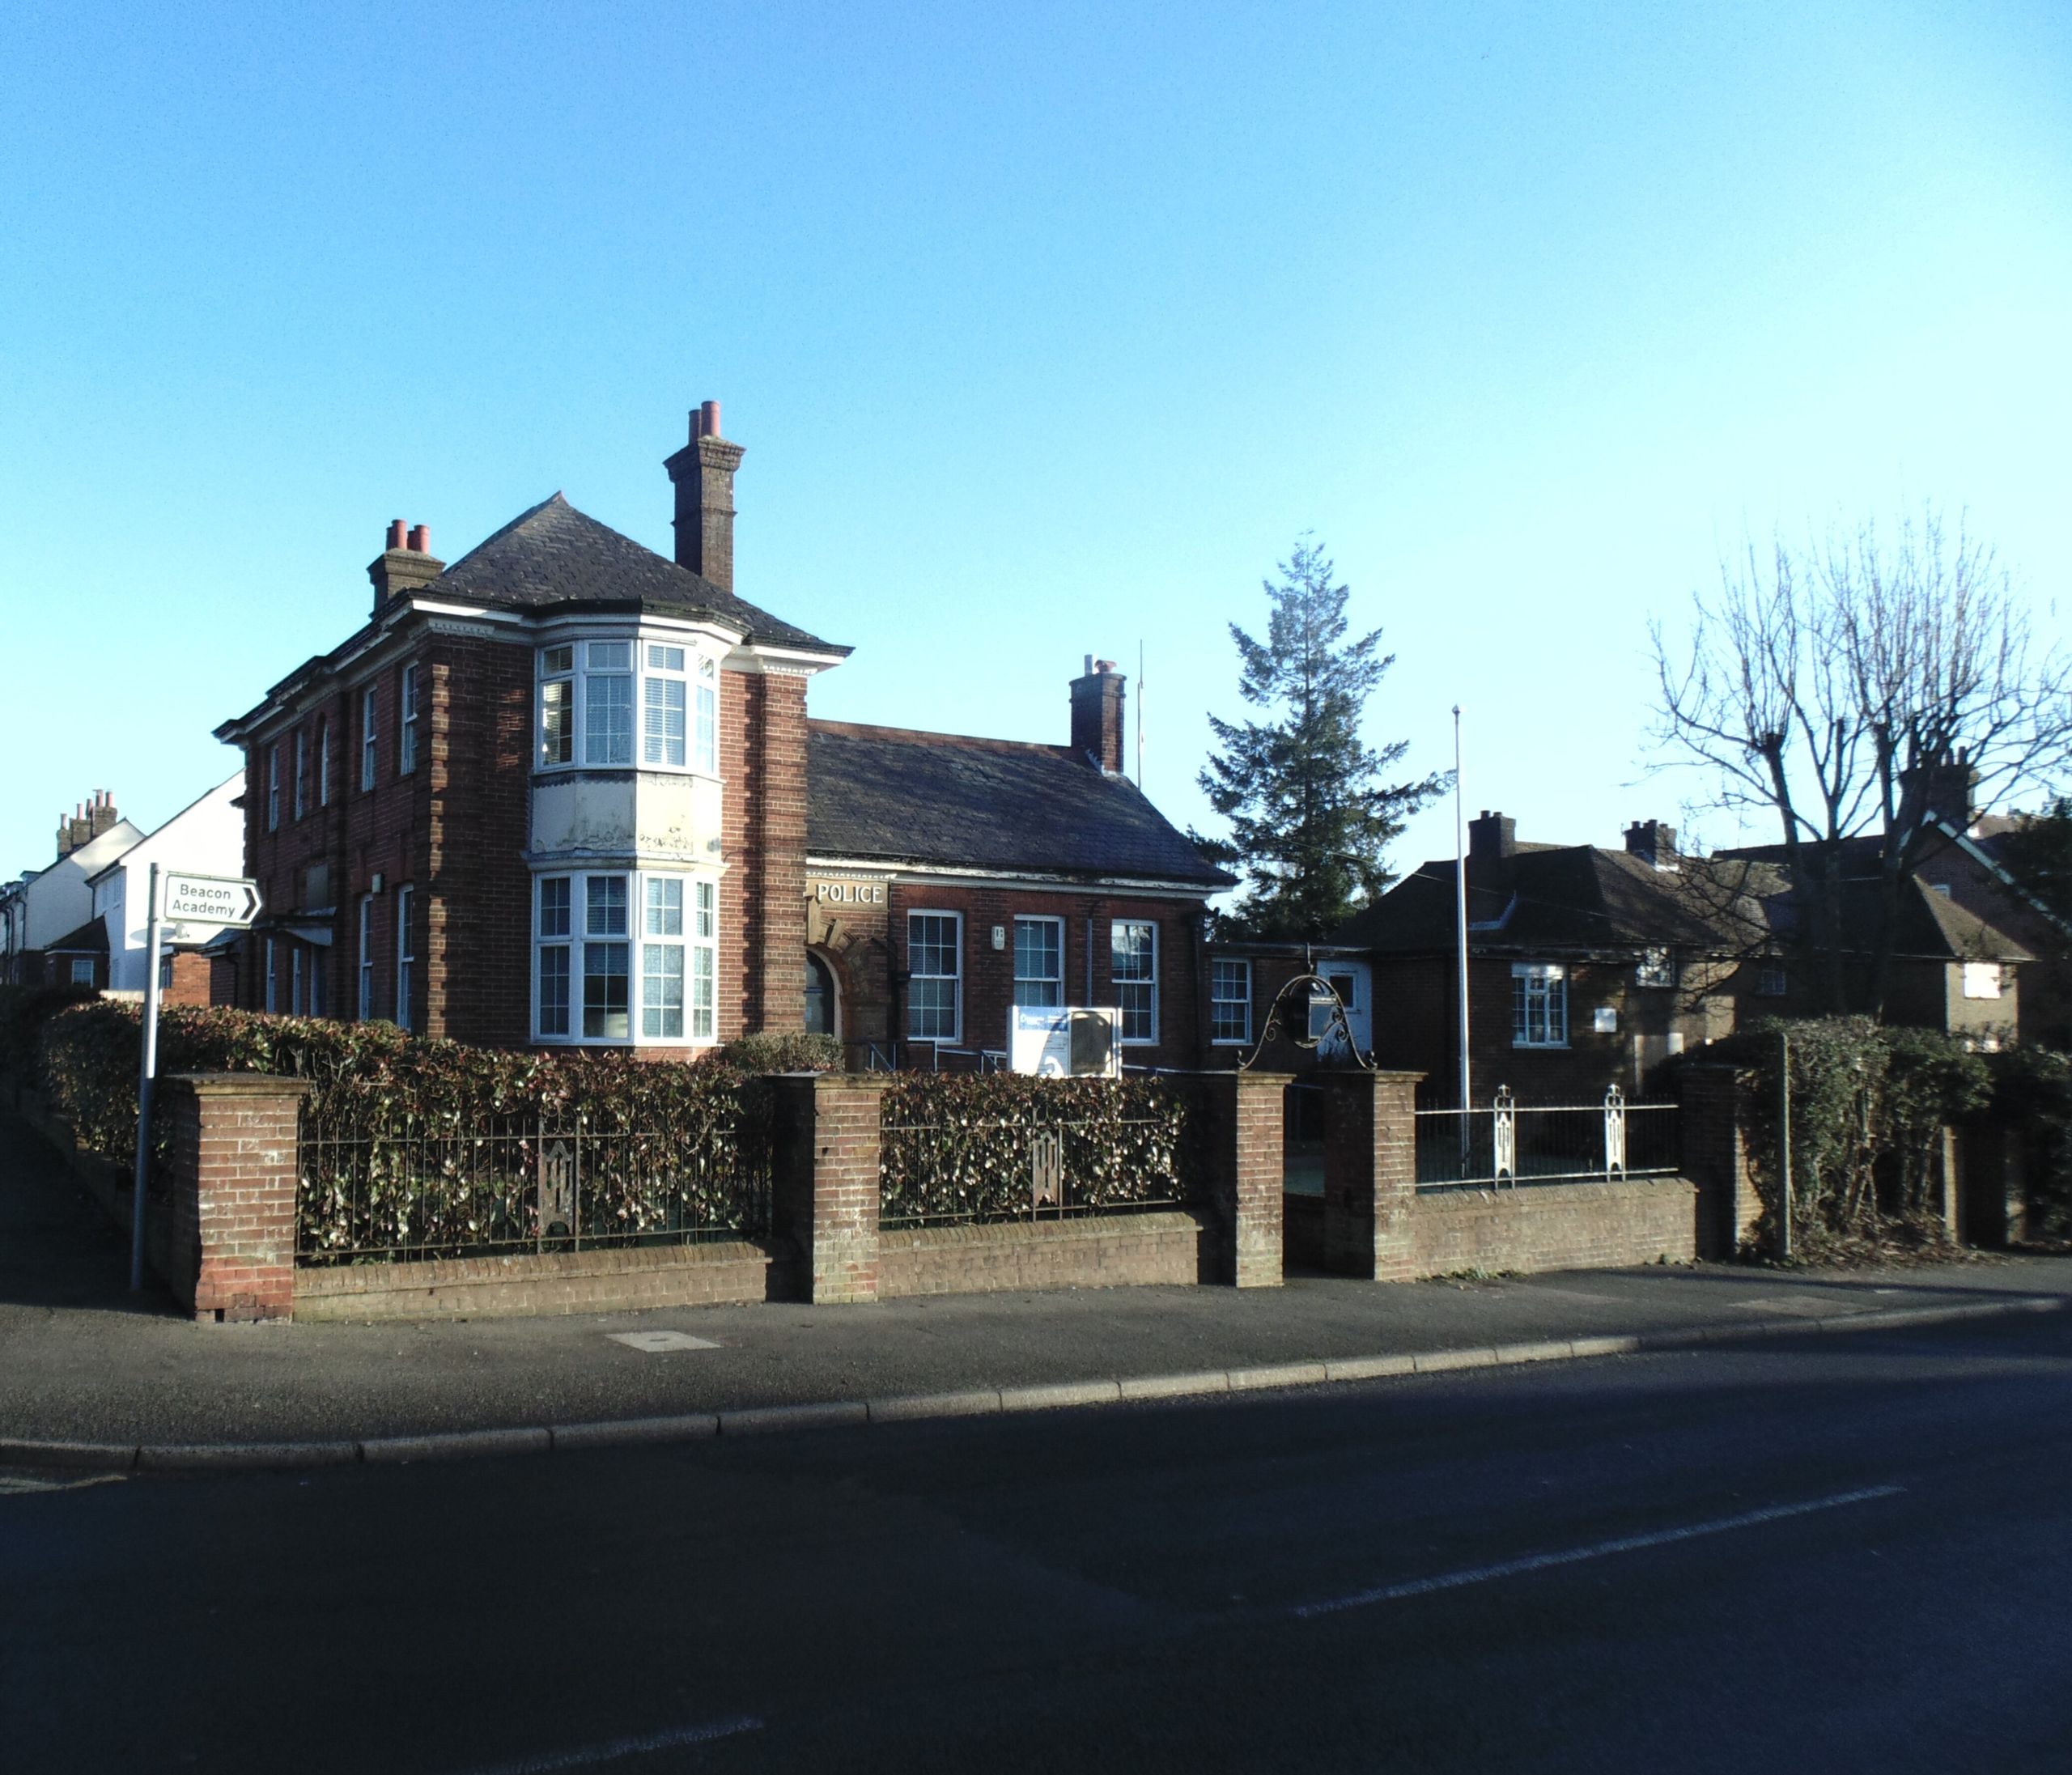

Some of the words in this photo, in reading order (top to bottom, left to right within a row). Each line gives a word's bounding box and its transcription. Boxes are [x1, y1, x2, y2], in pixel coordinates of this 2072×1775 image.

[180, 884, 231, 900] Beacon
[817, 883, 883, 903] POLICE
[172, 899, 236, 918] Academy
